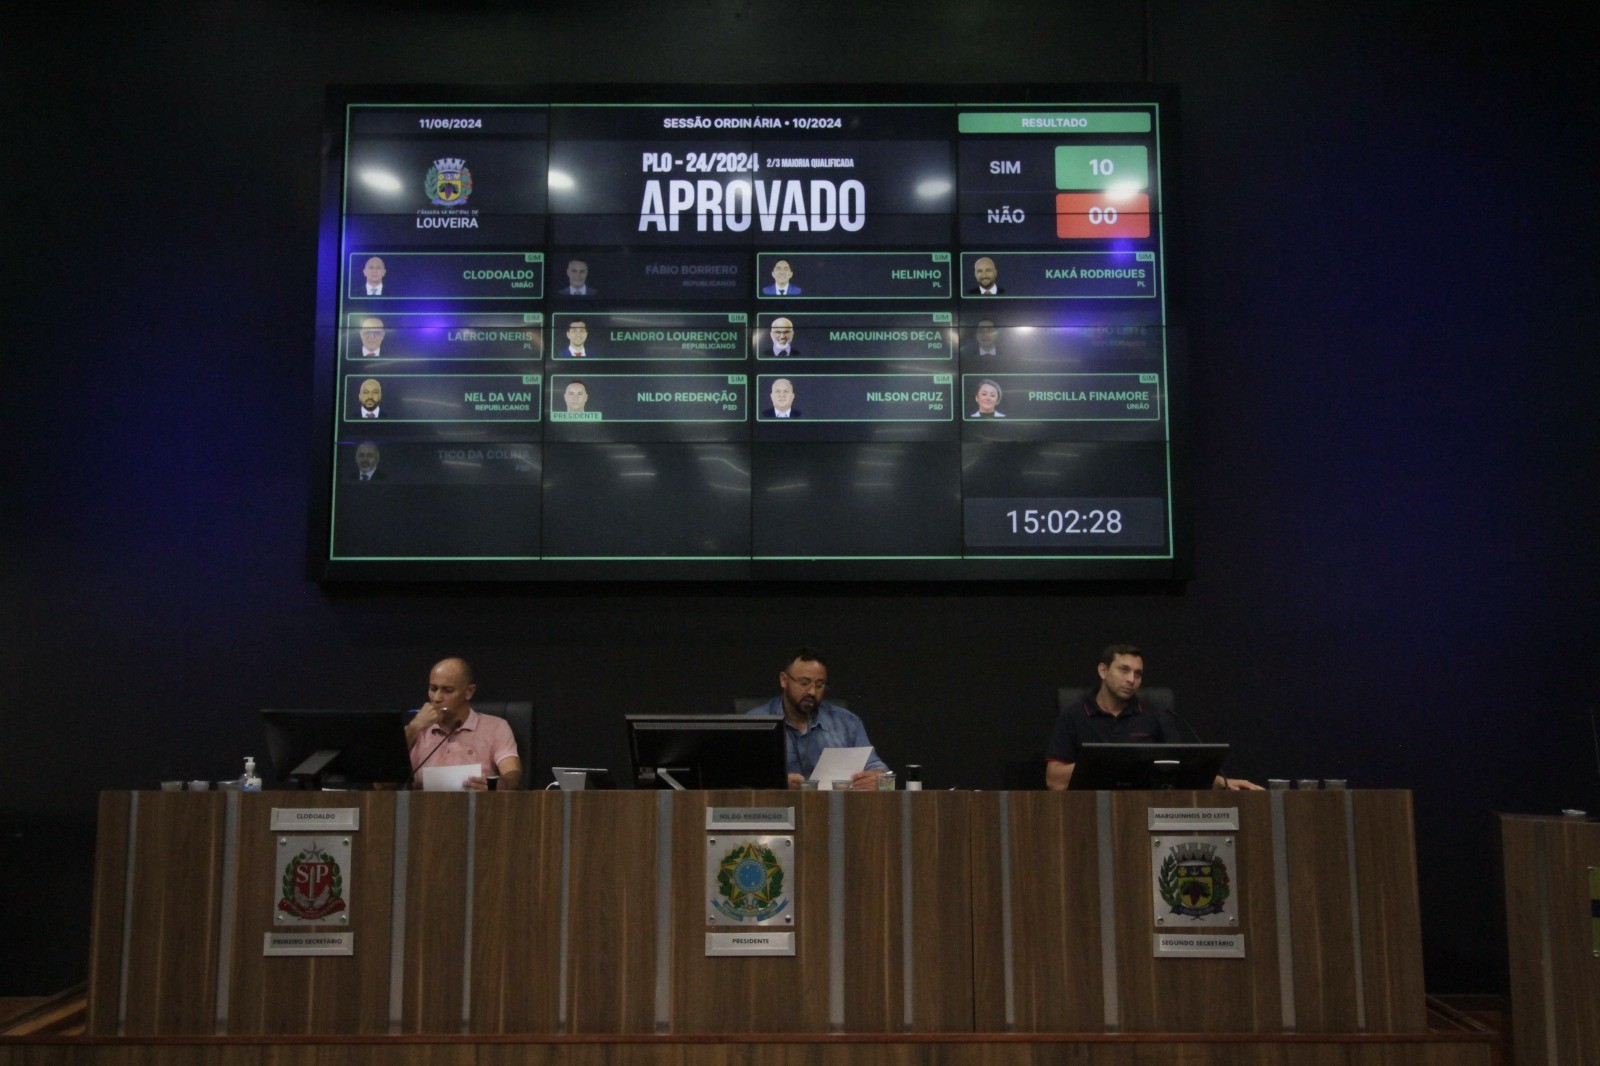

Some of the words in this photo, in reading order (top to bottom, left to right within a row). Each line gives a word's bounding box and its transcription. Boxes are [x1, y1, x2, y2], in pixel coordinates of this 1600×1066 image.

[419, 119, 482, 129] 11/06/2024
[663, 116, 711, 129] SESSÃO
[714, 116, 782, 129] ORDINÁRIA
[792, 118, 842, 129] 10/2024
[1022, 118, 1088, 128] RESULTADO
[642, 152, 672, 172] PLO
[686, 152, 759, 172] 24/2024
[766, 158, 780, 168] 2/3
[781, 158, 810, 168] MAIORIA
[811, 158, 854, 168] QUALIFICADA
[990, 160, 1021, 174] SIM
[1089, 159, 1114, 176] 10
[638, 179, 866, 232] APROVADO
[987, 205, 1025, 224] NÃO
[1088, 207, 1118, 225] 00
[416, 217, 479, 228] LOUVEIRA
[646, 263, 678, 275] FÁBIO
[681, 265, 738, 275] BORRIERO
[1046, 267, 1078, 279] KAKÁ
[1081, 269, 1146, 279] RODRIGUES
[463, 270, 534, 280] CLODOALDO
[892, 270, 941, 279] HELINHO
[500, 332, 533, 341] NERIS
[610, 331, 665, 341] LEANDRO
[667, 331, 738, 343] LOURENÇON
[829, 331, 908, 341] MARQUINHOS
[911, 331, 942, 341] DECA
[464, 392, 486, 402] NEL
[489, 392, 505, 402] DA
[508, 392, 531, 402] VAN
[637, 392, 672, 402] NILDO
[675, 390, 737, 404] REDENÇÃO
[866, 392, 909, 402] NILSON
[911, 392, 943, 402] CRUZ
[1028, 391, 1087, 401] PRISCILLA
[1089, 391, 1149, 401] FINAMORE
[928, 403, 943, 411] PSD
[1126, 402, 1150, 410] UNIÃO
[468, 450, 484, 460] DA
[1006, 509, 1123, 534] 15:02:28
